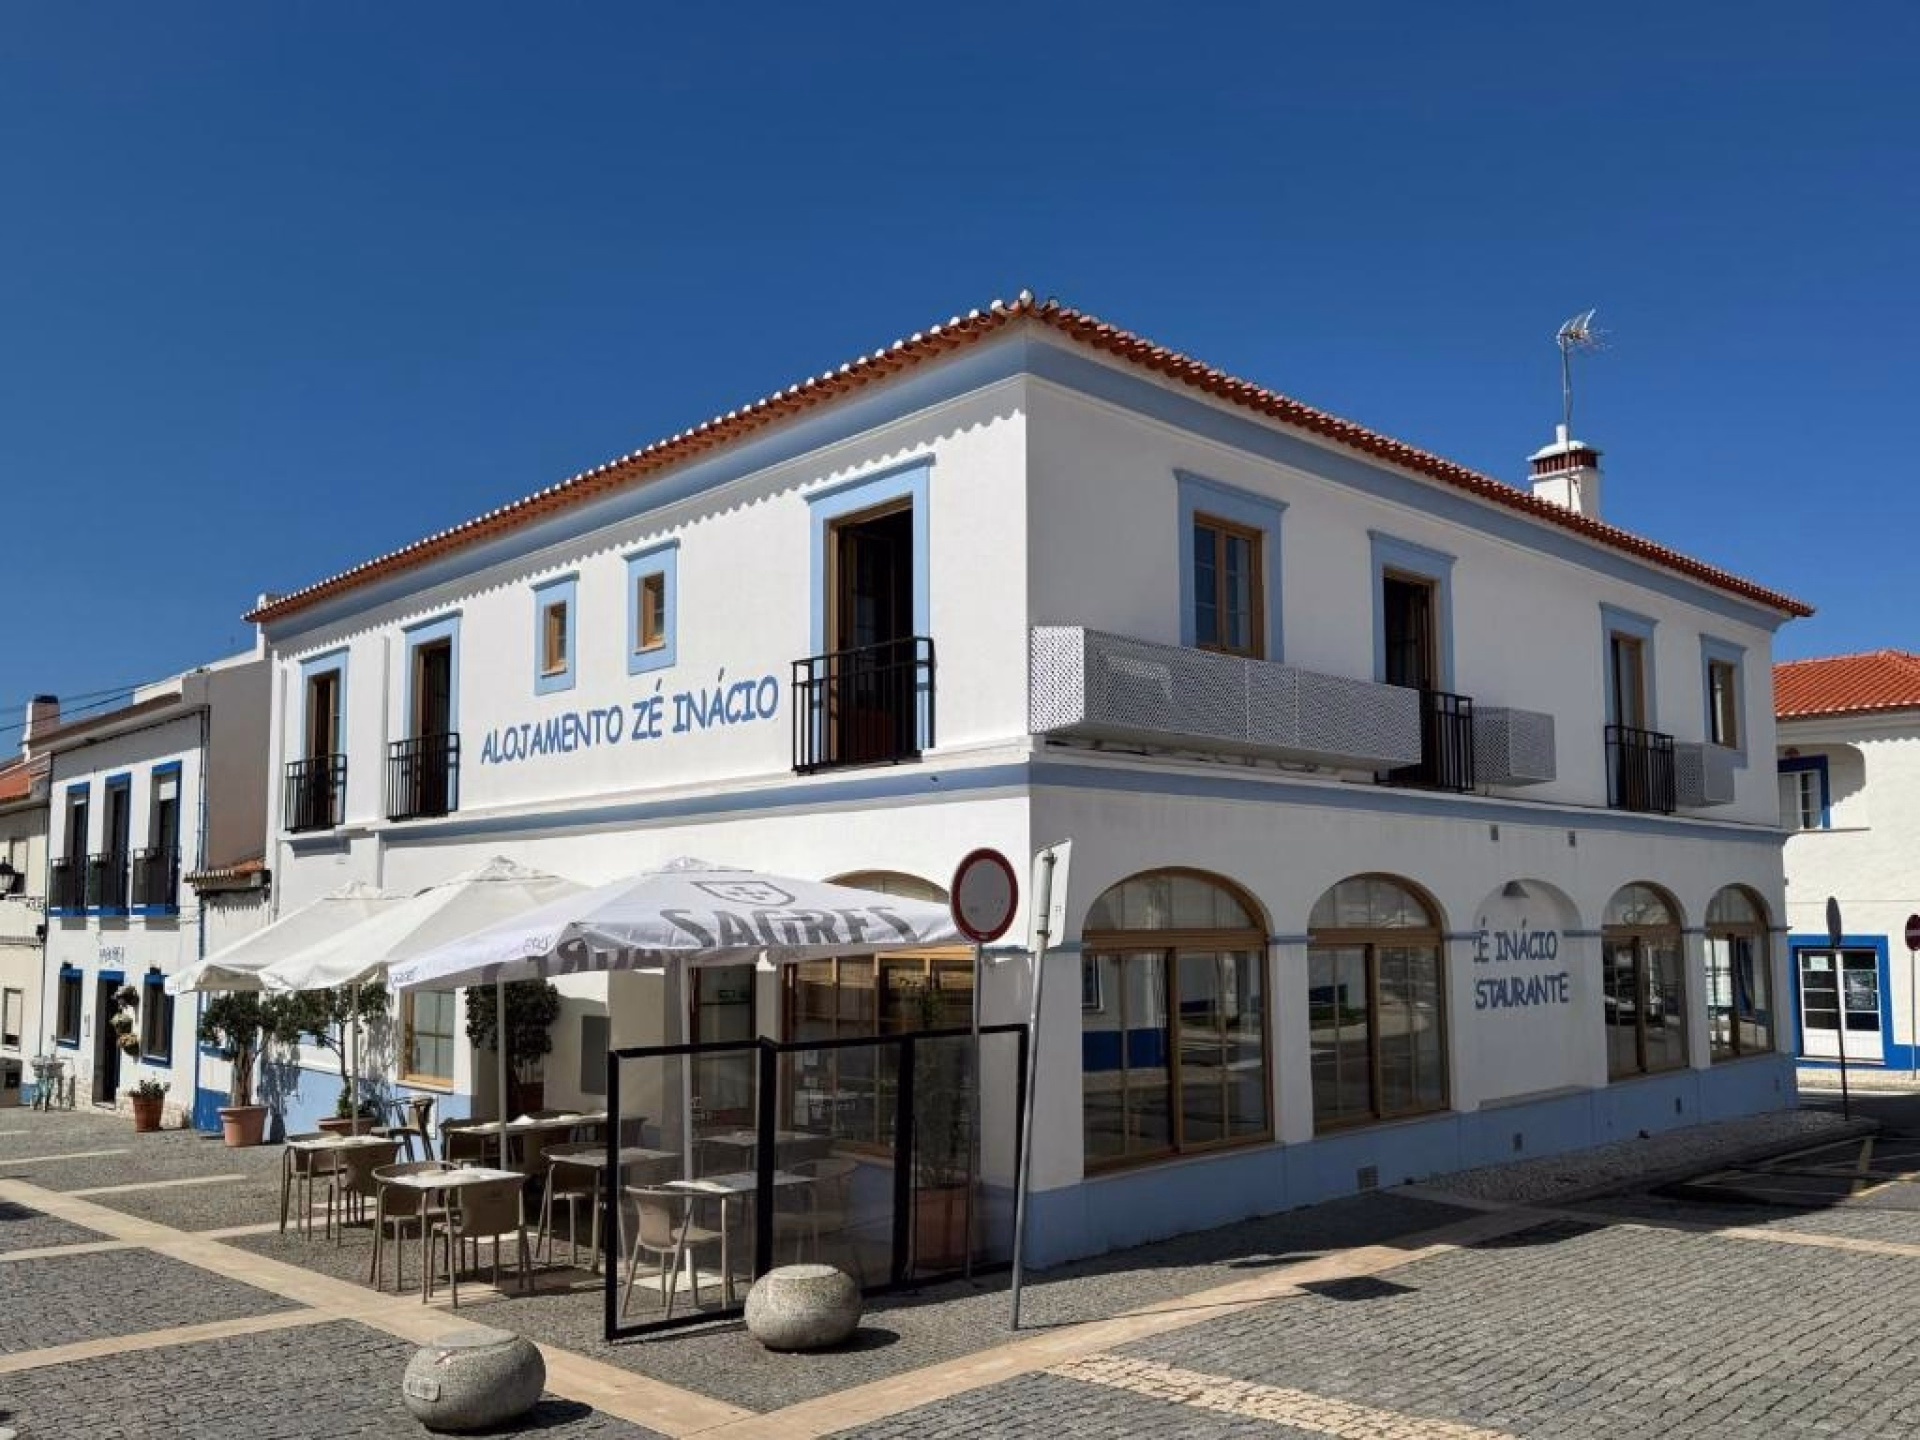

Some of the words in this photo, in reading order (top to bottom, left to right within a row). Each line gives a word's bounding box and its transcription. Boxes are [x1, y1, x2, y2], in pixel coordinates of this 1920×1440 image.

[481, 704, 623, 765] ALOJAMENTO
[631, 677, 664, 741] ZÉ
[672, 666, 779, 733] INÁCIO
[659, 906, 919, 949] SAGRES
[1494, 915, 1558, 961] INÁCIO
